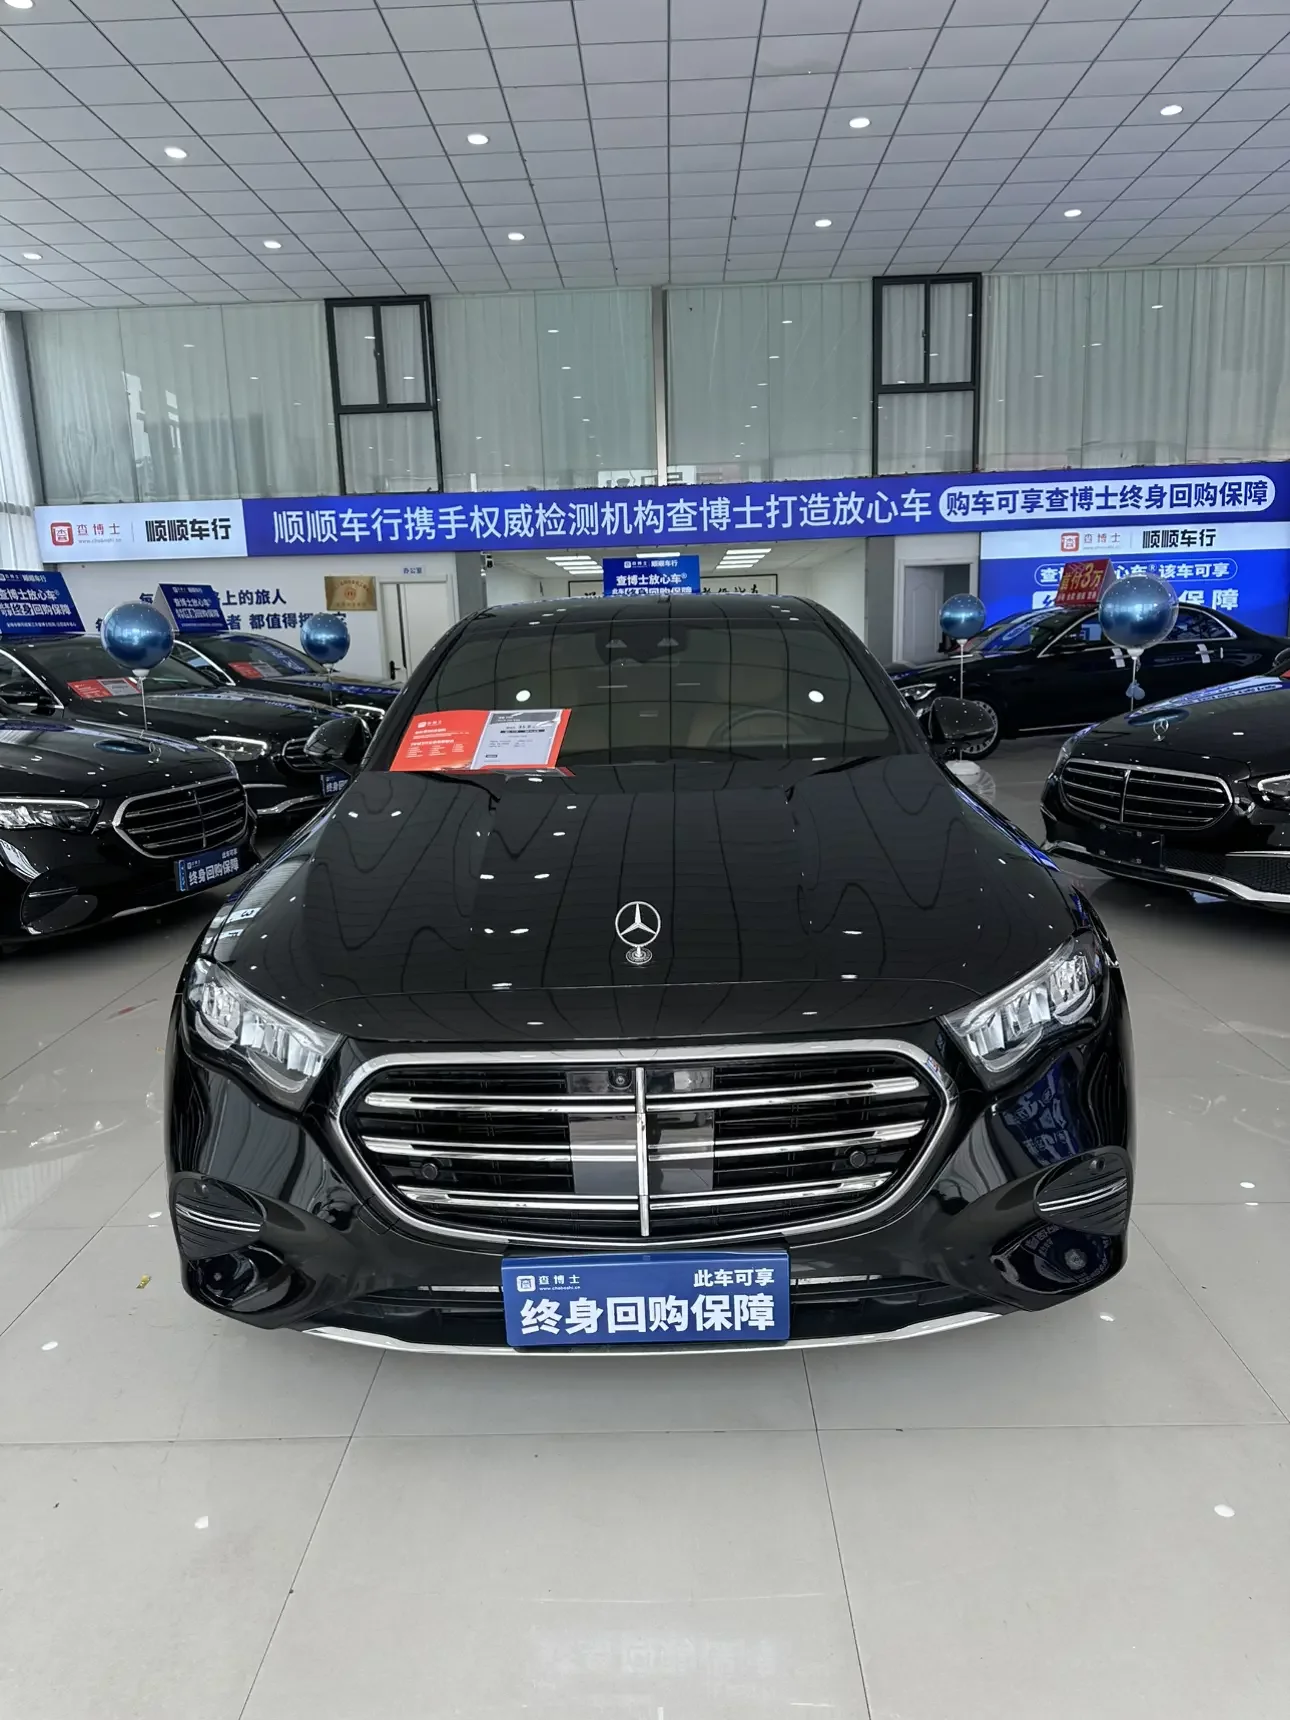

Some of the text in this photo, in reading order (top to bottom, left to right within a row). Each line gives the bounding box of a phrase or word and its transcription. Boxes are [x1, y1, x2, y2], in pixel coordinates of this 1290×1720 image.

[947, 480, 1268, 516] 购车可享查博士终身回购保障
[76, 518, 231, 543] 查博士 顺顺车行
[273, 488, 932, 544] 顺顺车行携手权威检测机构查博士打造放心车
[1084, 528, 1216, 549] 查博士 顺顺车行
[188, 857, 239, 886] 终身回购保障
[538, 1268, 775, 1288] 查博士 此车可享
[520, 1293, 775, 1335] 终身回购保障
